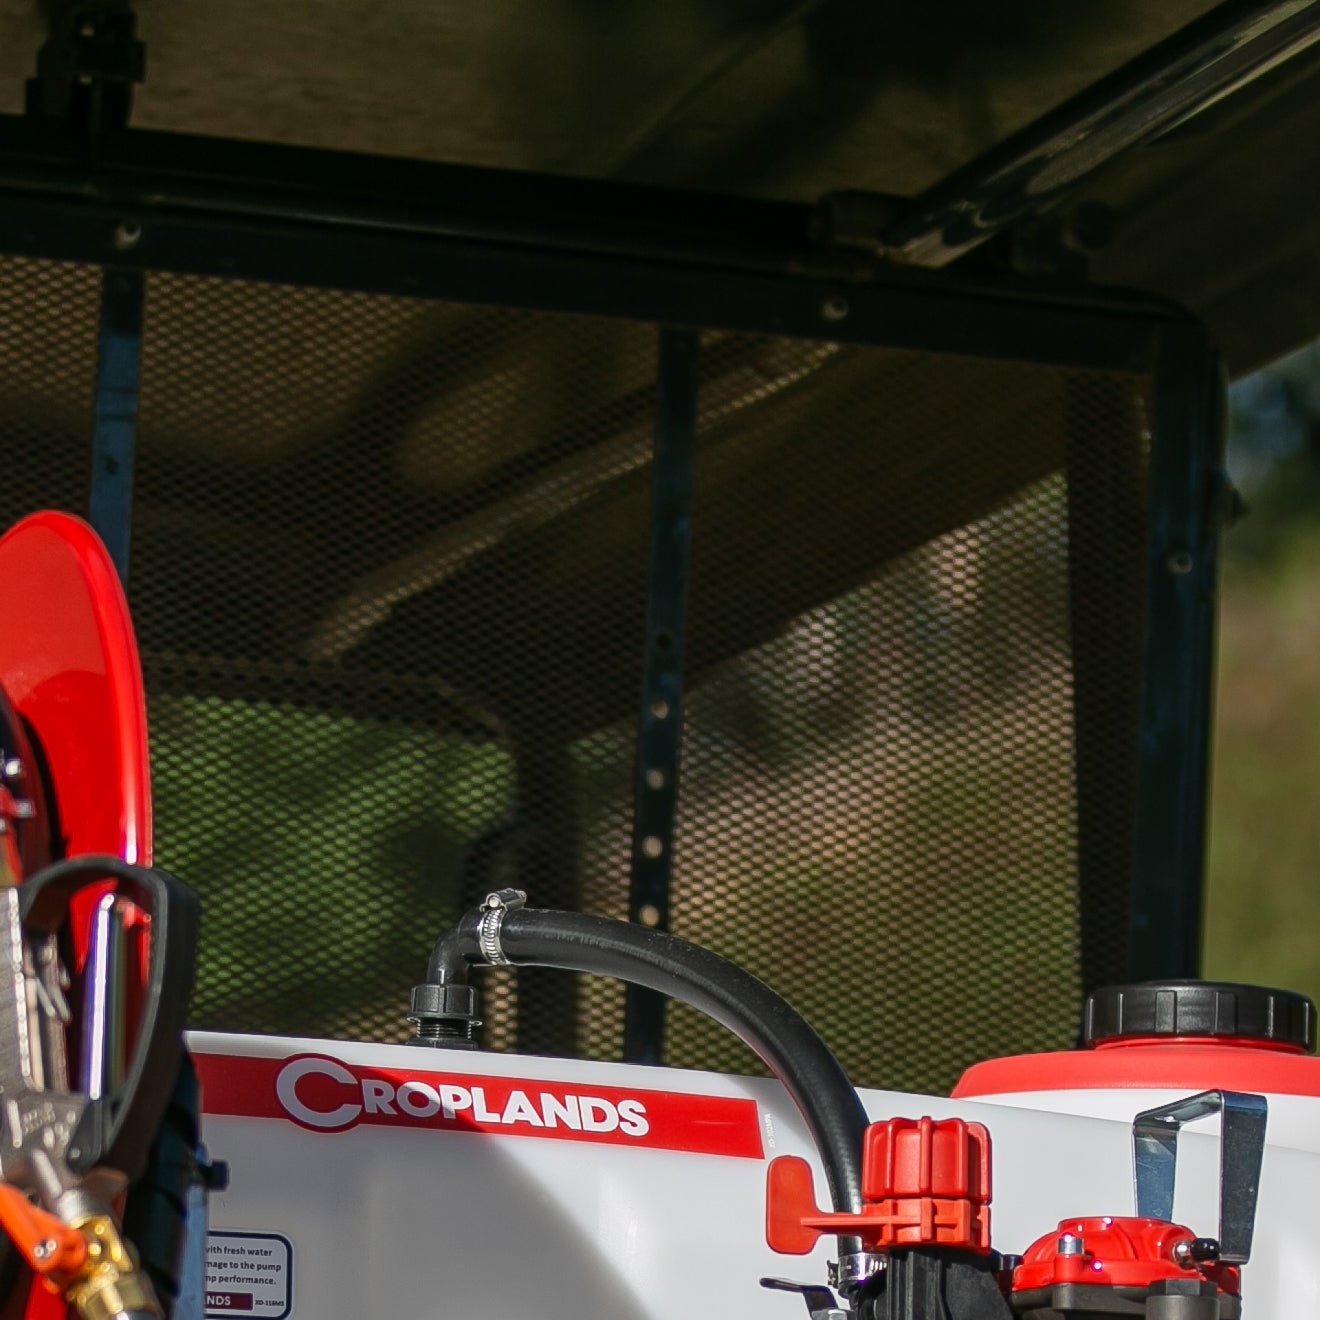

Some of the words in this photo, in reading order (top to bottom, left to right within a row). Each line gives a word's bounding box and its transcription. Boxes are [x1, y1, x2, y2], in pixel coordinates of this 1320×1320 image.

[276, 1057, 649, 1137] CROPLANDS
[224, 1246, 245, 1255] fresh
[247, 1249, 272, 1257] water
[230, 1261, 239, 1269] to
[240, 1261, 255, 1269] the
[256, 1264, 282, 1272] pump
[218, 1275, 277, 1285] performance.
